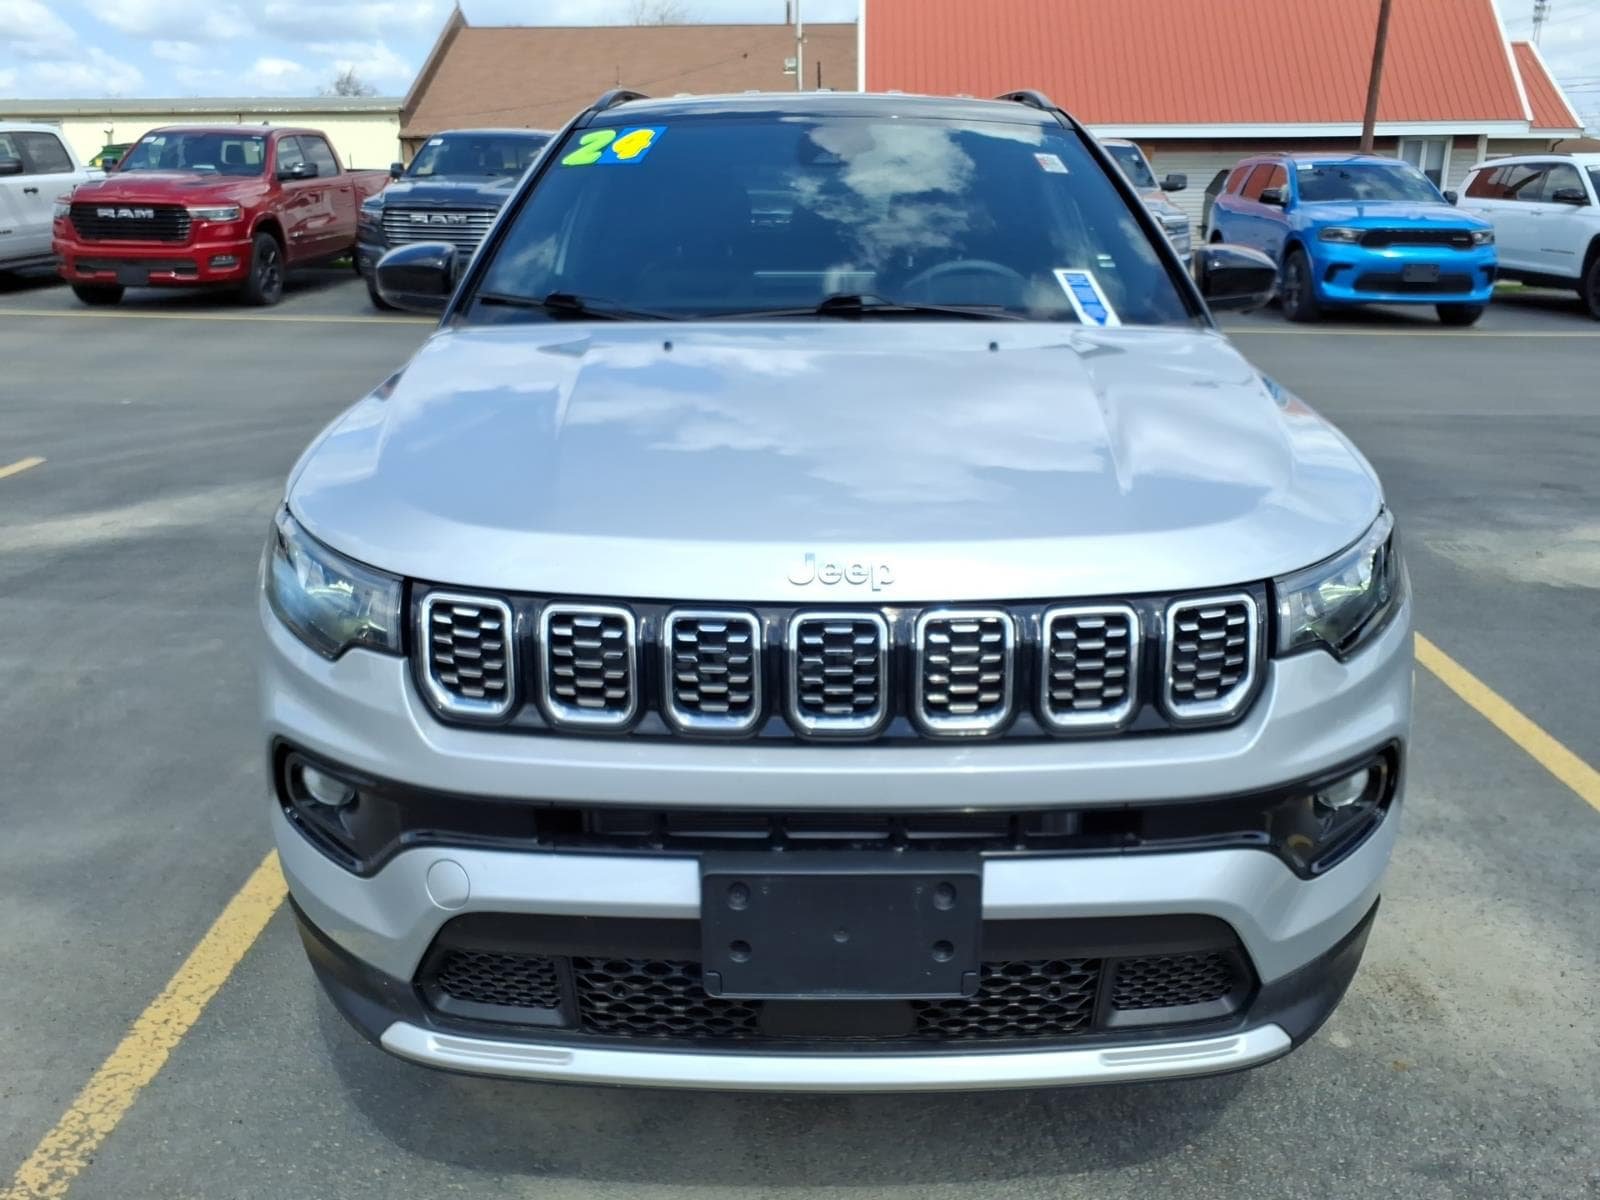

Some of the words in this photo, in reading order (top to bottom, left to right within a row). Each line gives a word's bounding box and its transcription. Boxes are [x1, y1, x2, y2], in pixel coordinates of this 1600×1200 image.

[97, 208, 154, 218] RAM
[410, 213, 467, 224] RAM
[786, 552, 896, 592] Jeep
